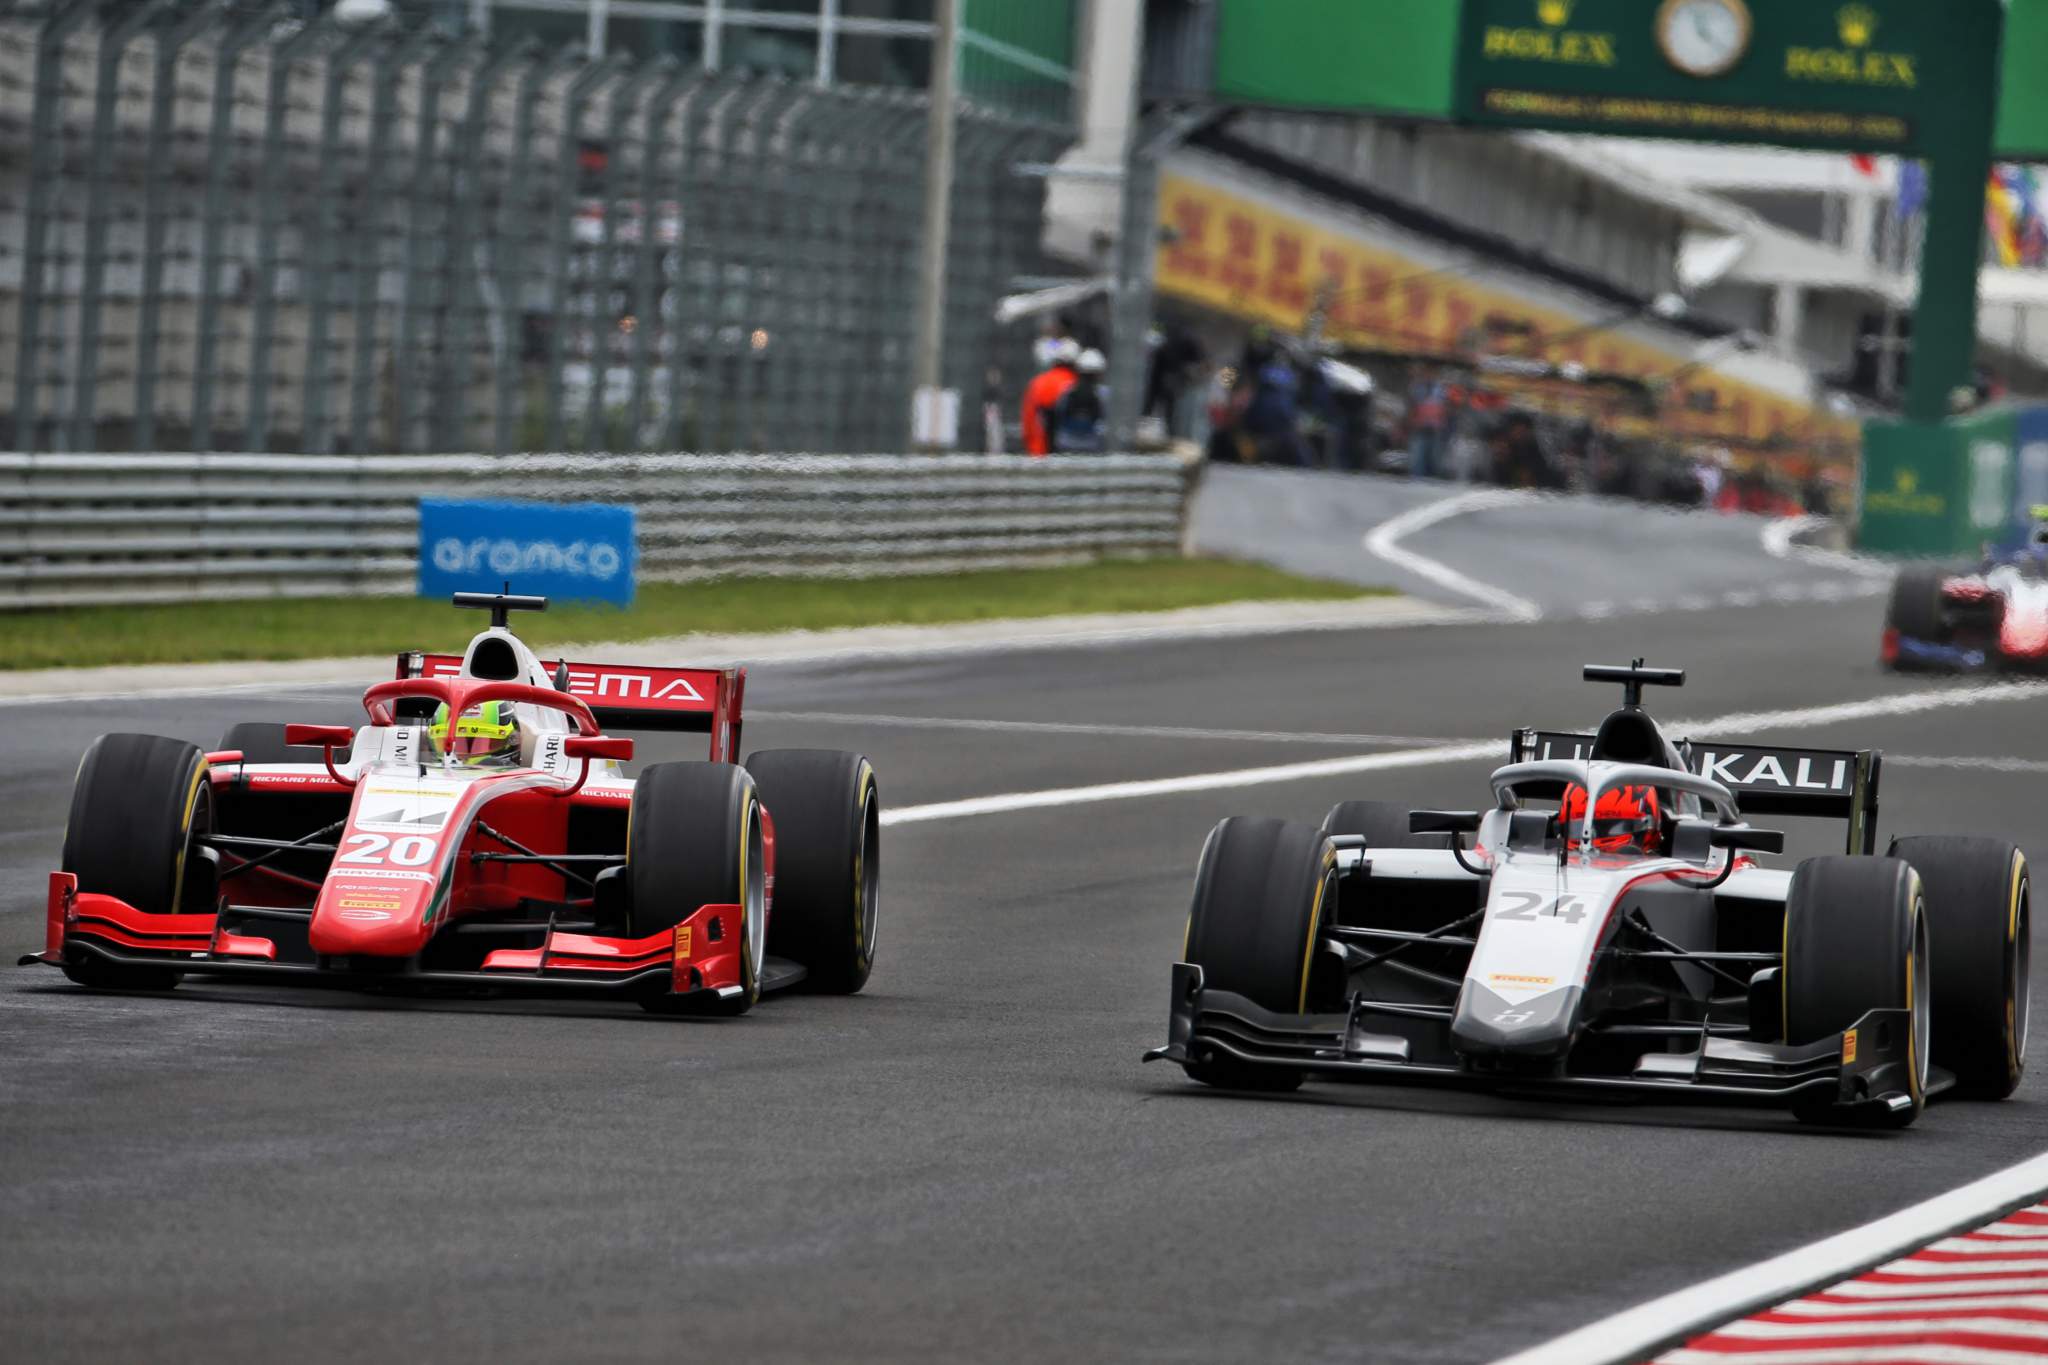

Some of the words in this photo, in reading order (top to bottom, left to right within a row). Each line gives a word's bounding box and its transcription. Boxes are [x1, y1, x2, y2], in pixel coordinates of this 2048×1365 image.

[1484, 25, 1616, 67] ROLEX
[1785, 46, 1917, 87] ROLEX
[433, 537, 620, 580] aramco
[252, 775, 307, 784] RICHARD
[338, 833, 438, 866] 20
[1494, 891, 1587, 924] 24
